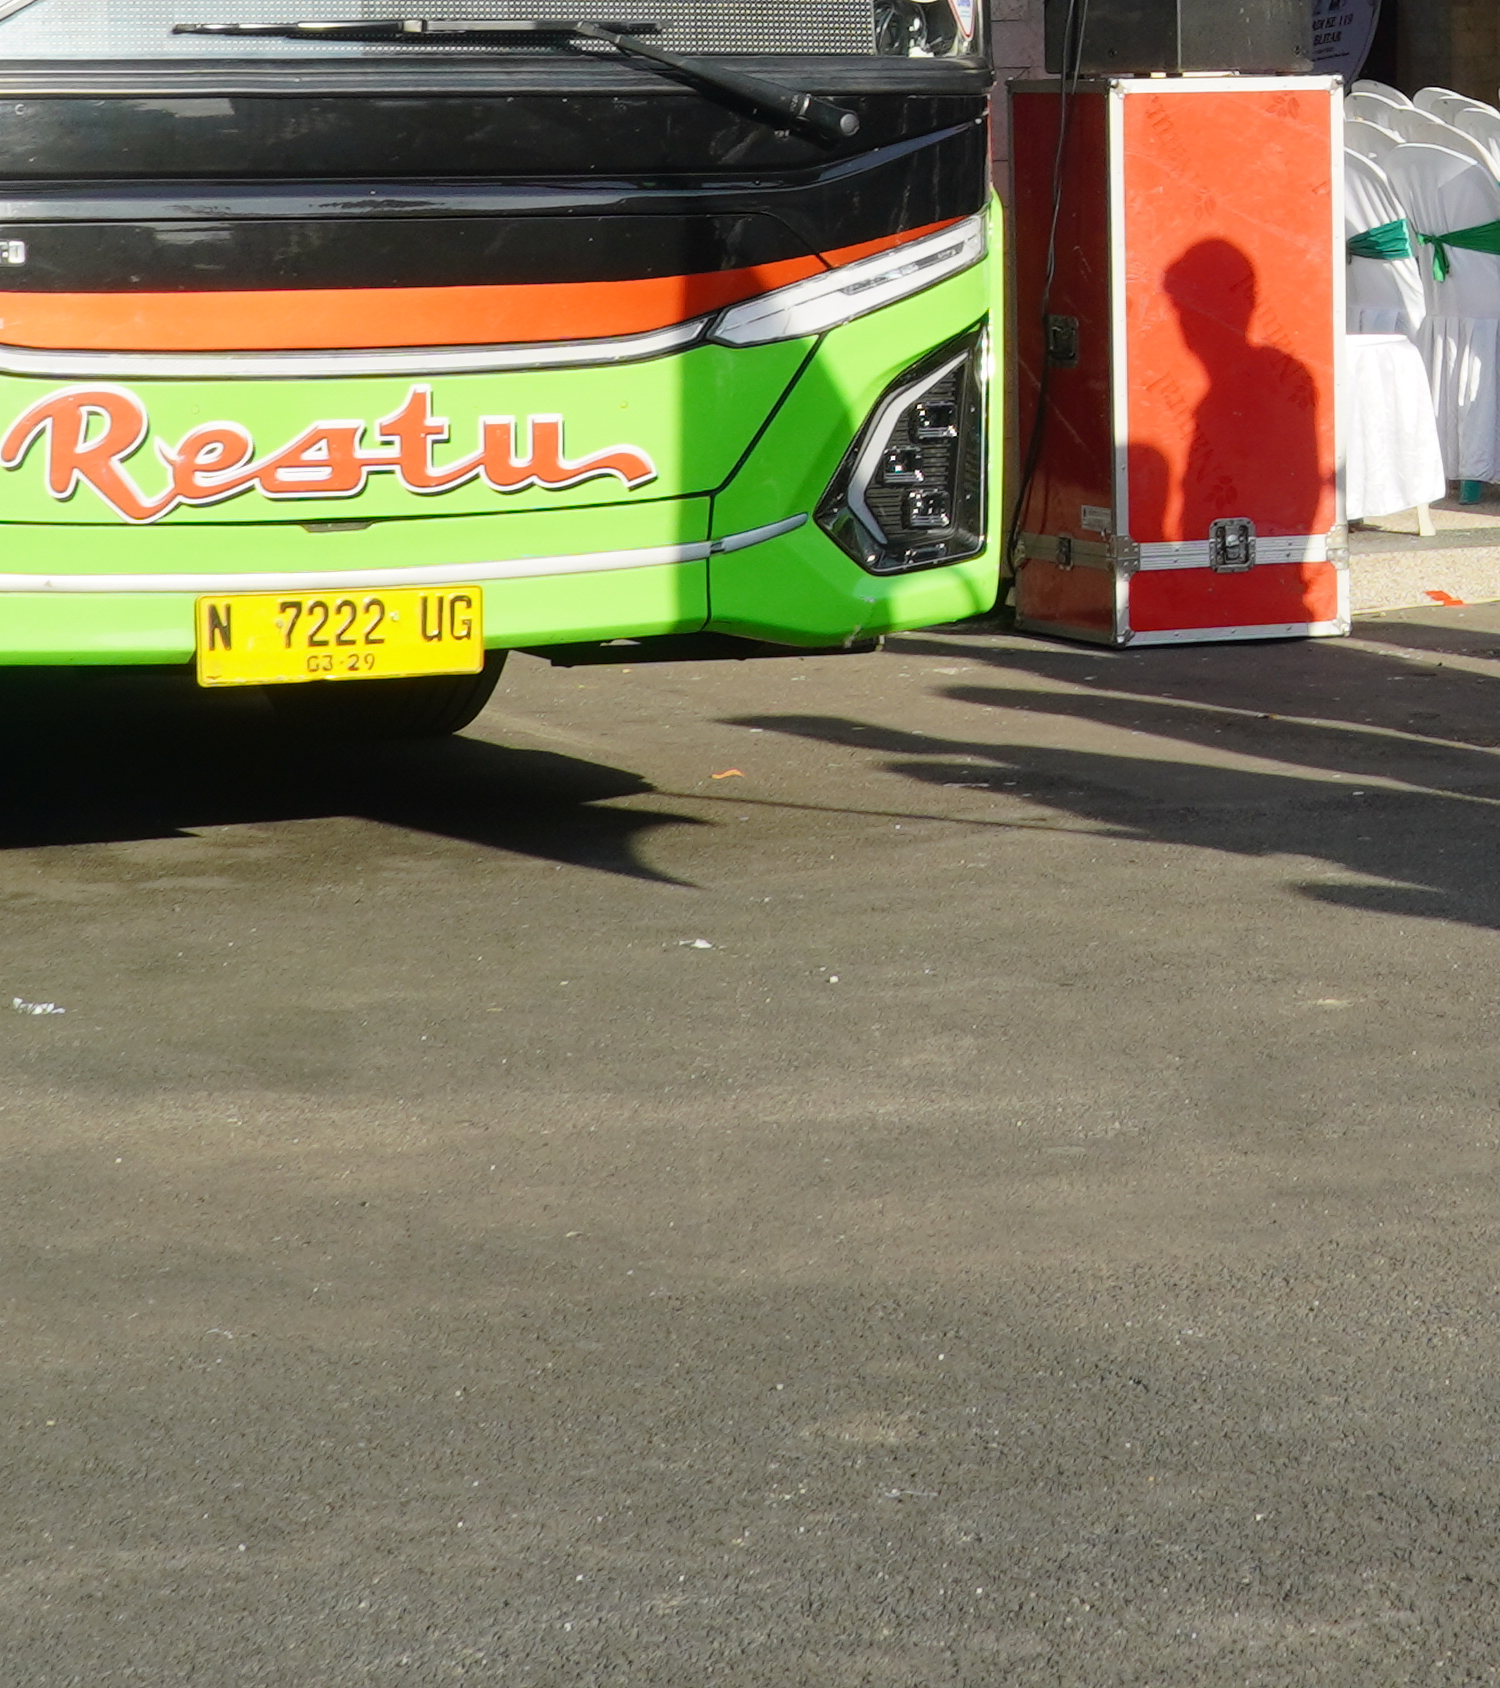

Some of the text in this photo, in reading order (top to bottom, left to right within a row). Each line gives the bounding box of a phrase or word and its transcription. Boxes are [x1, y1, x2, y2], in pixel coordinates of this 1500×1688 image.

[208, 595, 473, 651] N 7222 UG
